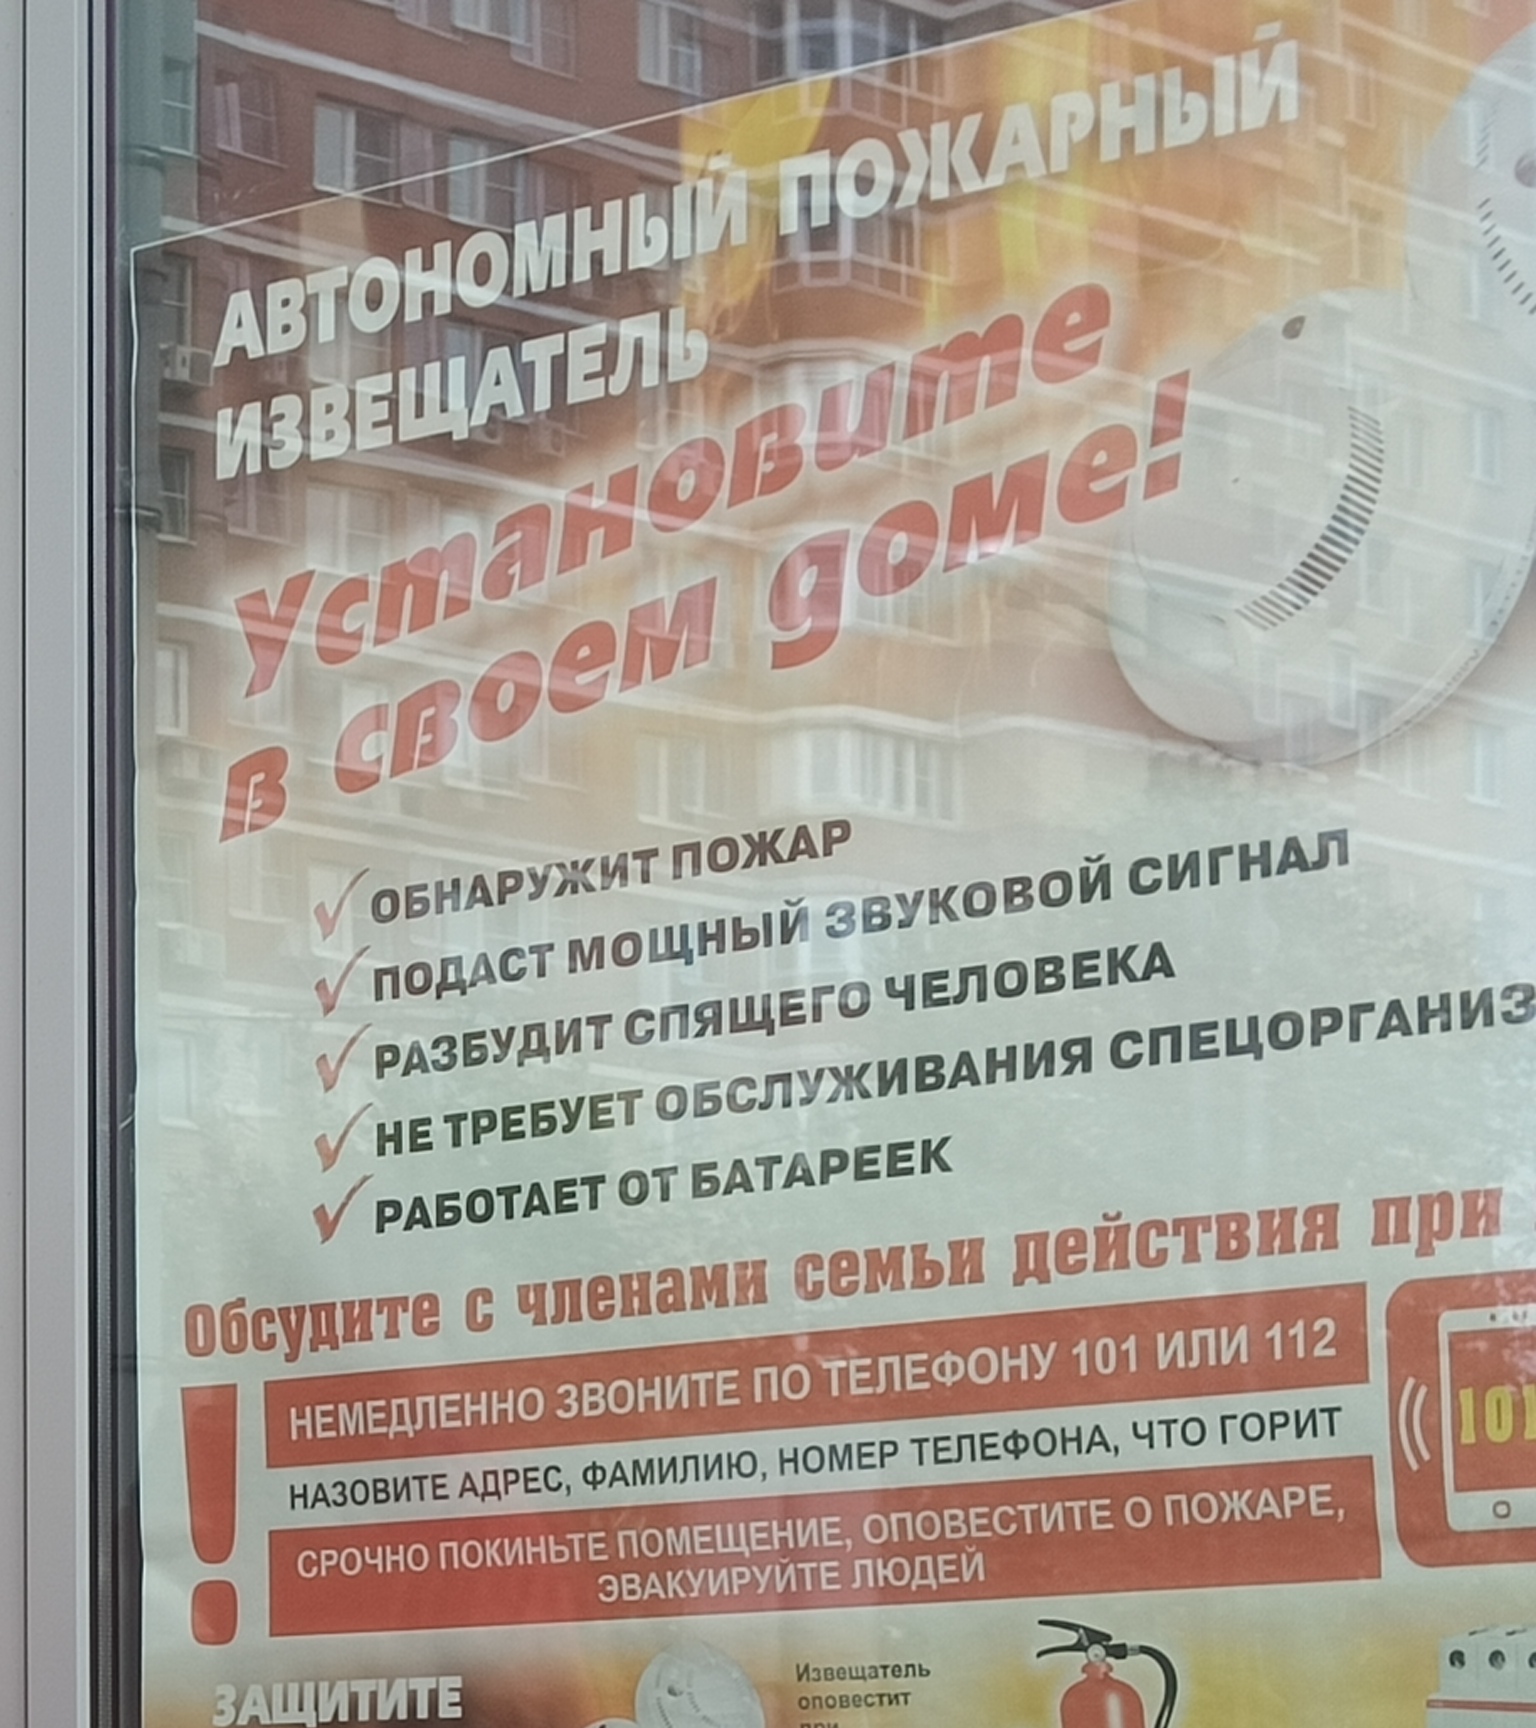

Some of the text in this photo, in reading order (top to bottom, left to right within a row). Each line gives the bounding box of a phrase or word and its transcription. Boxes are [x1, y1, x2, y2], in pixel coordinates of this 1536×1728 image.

[213, 22, 1300, 368] АВТОНОМНЫЙ ПОЖАРНЫЙ
[215, 308, 709, 481] ИЗВЕЩАТЕЛЬ
[234, 281, 1111, 699] Установите
[218, 369, 1191, 842] в своем доме!
[370, 820, 852, 925] ОБНАРУЖИТ ПОЖАР
[373, 827, 1351, 1003] ПОДАСТ МОЩНЫЙ ЗВУКОВОЙ СИГНАЛ
[374, 940, 1174, 1081] РАЗБУДИТ СПЯЩЕГО ЧЕЛОВЕКА
[376, 1118, 433, 1157] НЕ
[445, 1090, 643, 1148] ТРЕБУЕТ
[656, 1035, 1094, 1121] ОБСЛУЖИВАНИЯ
[374, 1138, 951, 1234] РАБОТАЕТ ОТ БАТАРЕЕК
[183, 1187, 1503, 1364] Обсудите с членами семьи действия при
[289, 1316, 1337, 1442] НЕМЕДЛЕННО ЗВОНИТЕ ПО ТЕЛЕФОНУ 101 ИЛИ 112
[290, 1405, 1341, 1510] НАЗОВИТЕ АДРЕС, ФАМИЛИЮ, НОМЕР ТЕЛЕФОНА, ЧТО ГОРИТ
[296, 1481, 1346, 1581] СРОЧНО ПОКИНЬТЕ ПОМЕЩЕНИЕ, ОПОВЕСТИТЕ О ПОЖАРЕ,
[598, 1548, 984, 1607] ЭВАКУИРУЙТЕ ЛЮДЕЙ
[213, 1674, 462, 1728] ЗАЩИТИТЕ
[796, 1660, 931, 1684] Извещатель
[798, 1690, 913, 1711] оповестит
